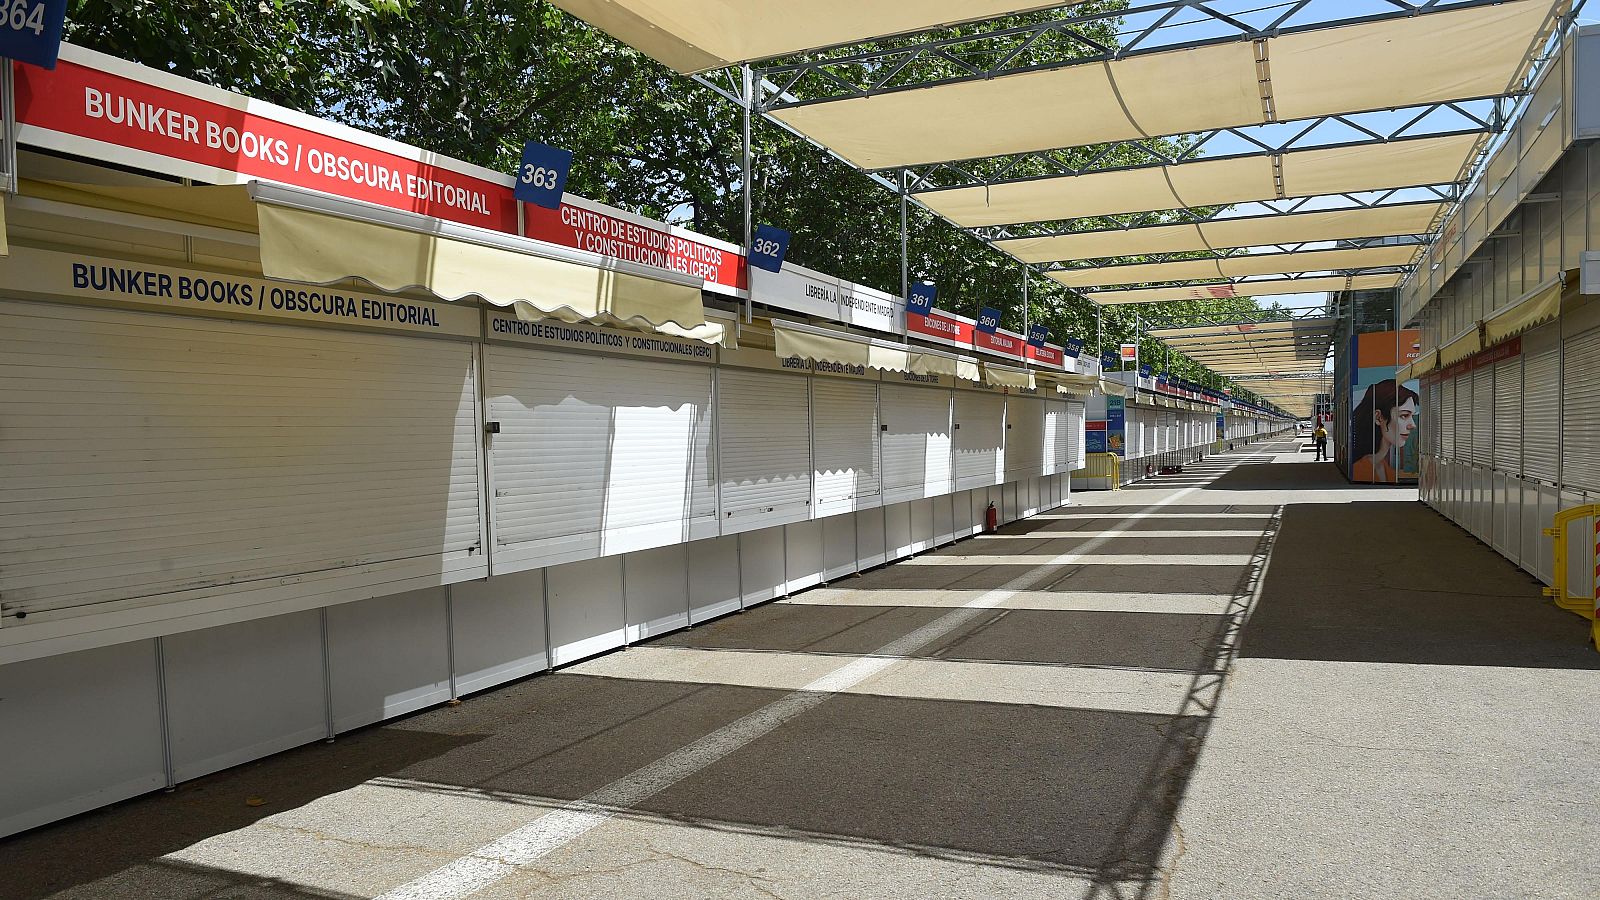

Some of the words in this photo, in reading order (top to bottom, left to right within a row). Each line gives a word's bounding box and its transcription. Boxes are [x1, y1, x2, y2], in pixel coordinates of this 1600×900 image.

[84, 86, 200, 144] BUNKER
[205, 119, 289, 167] BOOKS
[293, 144, 303, 173] /
[306, 146, 403, 195] OBSCURA
[406, 172, 491, 217] EDITORIAL
[521, 163, 558, 191] 363
[561, 206, 609, 235] CENTRO
[611, 219, 625, 240] DE
[626, 224, 676, 254] ESTUDIOS
[575, 229, 583, 249] Y
[586, 233, 688, 274] CONSTITUCIONALES
[689, 259, 718, 284] (CEPC)
[754, 237, 780, 258] 362
[72, 263, 173, 299] BUNKER
[178, 275, 254, 306] BOOKS
[258, 278, 266, 310] /
[270, 288, 358, 318] OBSCURA
[360, 300, 440, 328] EDITORIAL
[830, 290, 838, 304] LA
[840, 293, 877, 315] INDEPENDIENTE
[877, 304, 894, 319] MADRID
[910, 293, 929, 308] 361
[980, 315, 996, 328] 360
[493, 318, 530, 336] CENTRO
[532, 323, 543, 338] DE
[544, 325, 584, 343] ESTUDIOS
[585, 329, 623, 347] POLÍTICOS
[624, 337, 630, 348] Y
[632, 337, 693, 356] CONSTITUCIONALES
[693, 345, 712, 360] (CEPC)
[1031, 331, 1045, 341] 359
[1066, 342, 1079, 352] 358
